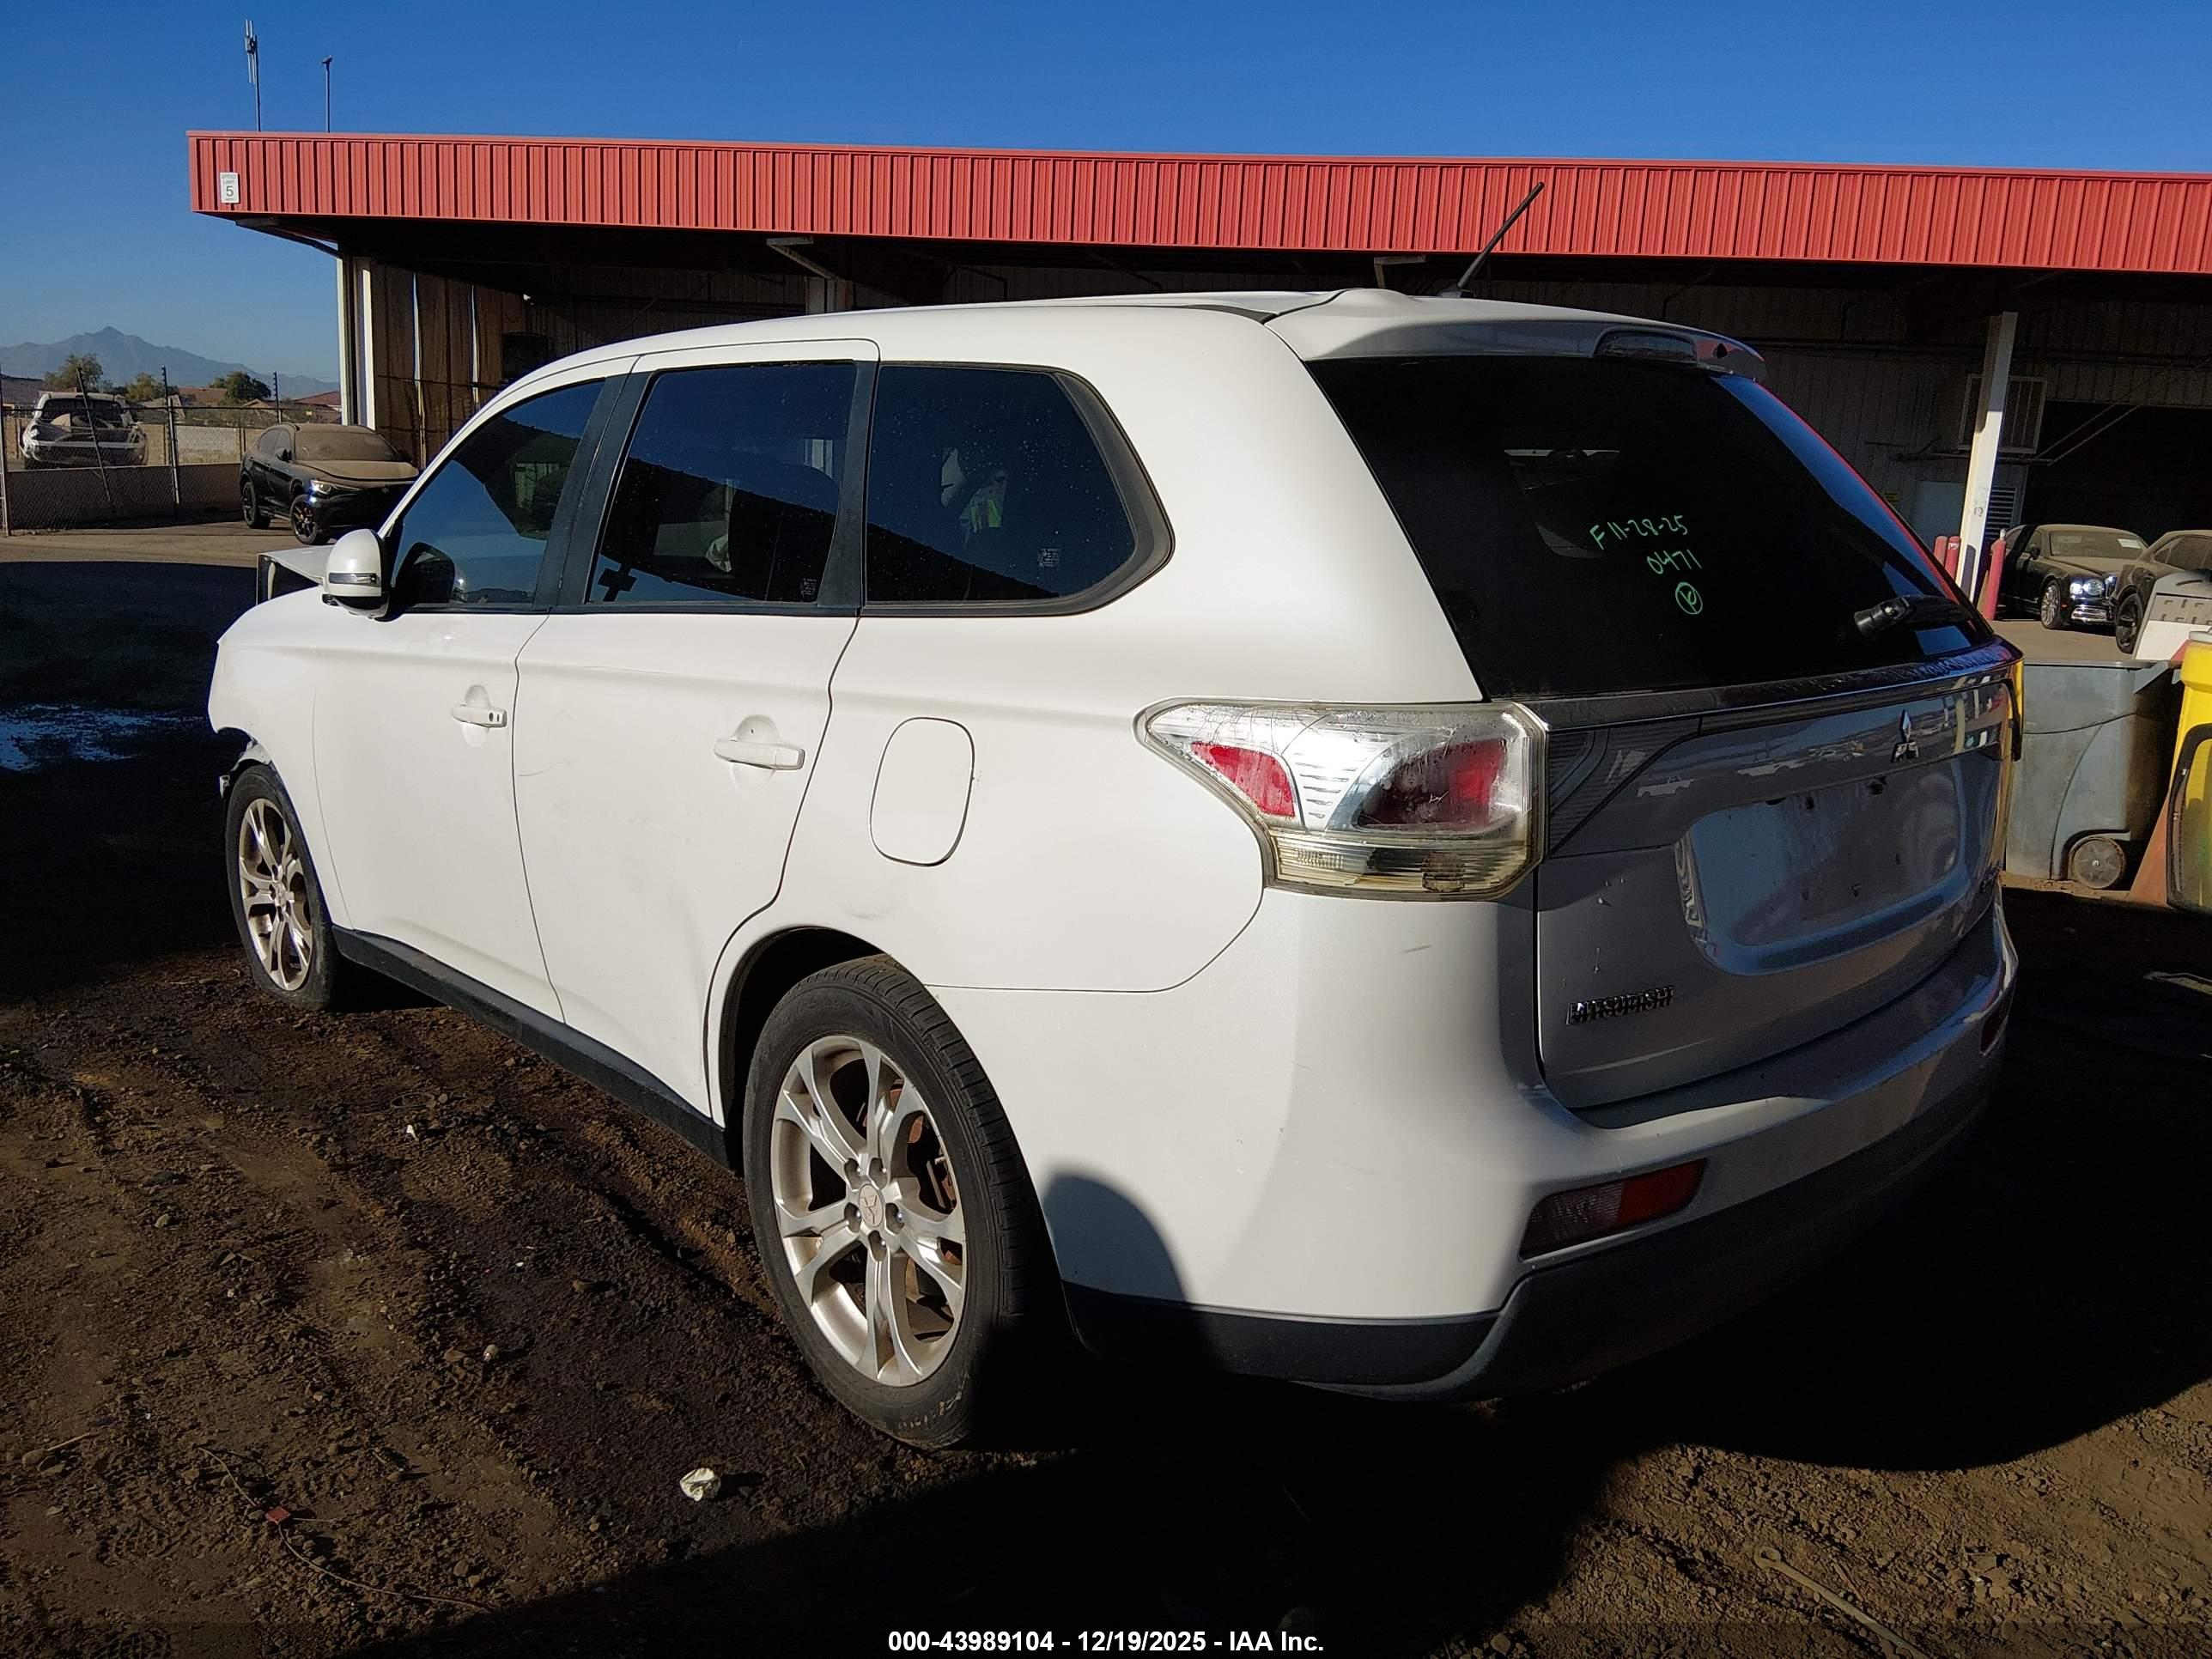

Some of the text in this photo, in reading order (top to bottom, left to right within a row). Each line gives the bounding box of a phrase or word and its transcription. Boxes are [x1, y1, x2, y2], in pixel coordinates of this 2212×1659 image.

[226, 185, 234, 197] 5
[1589, 514, 1688, 550] F 11-28-25
[1646, 549, 1702, 574] 0471
[1565, 985, 1675, 1025] MITSUBISHI
